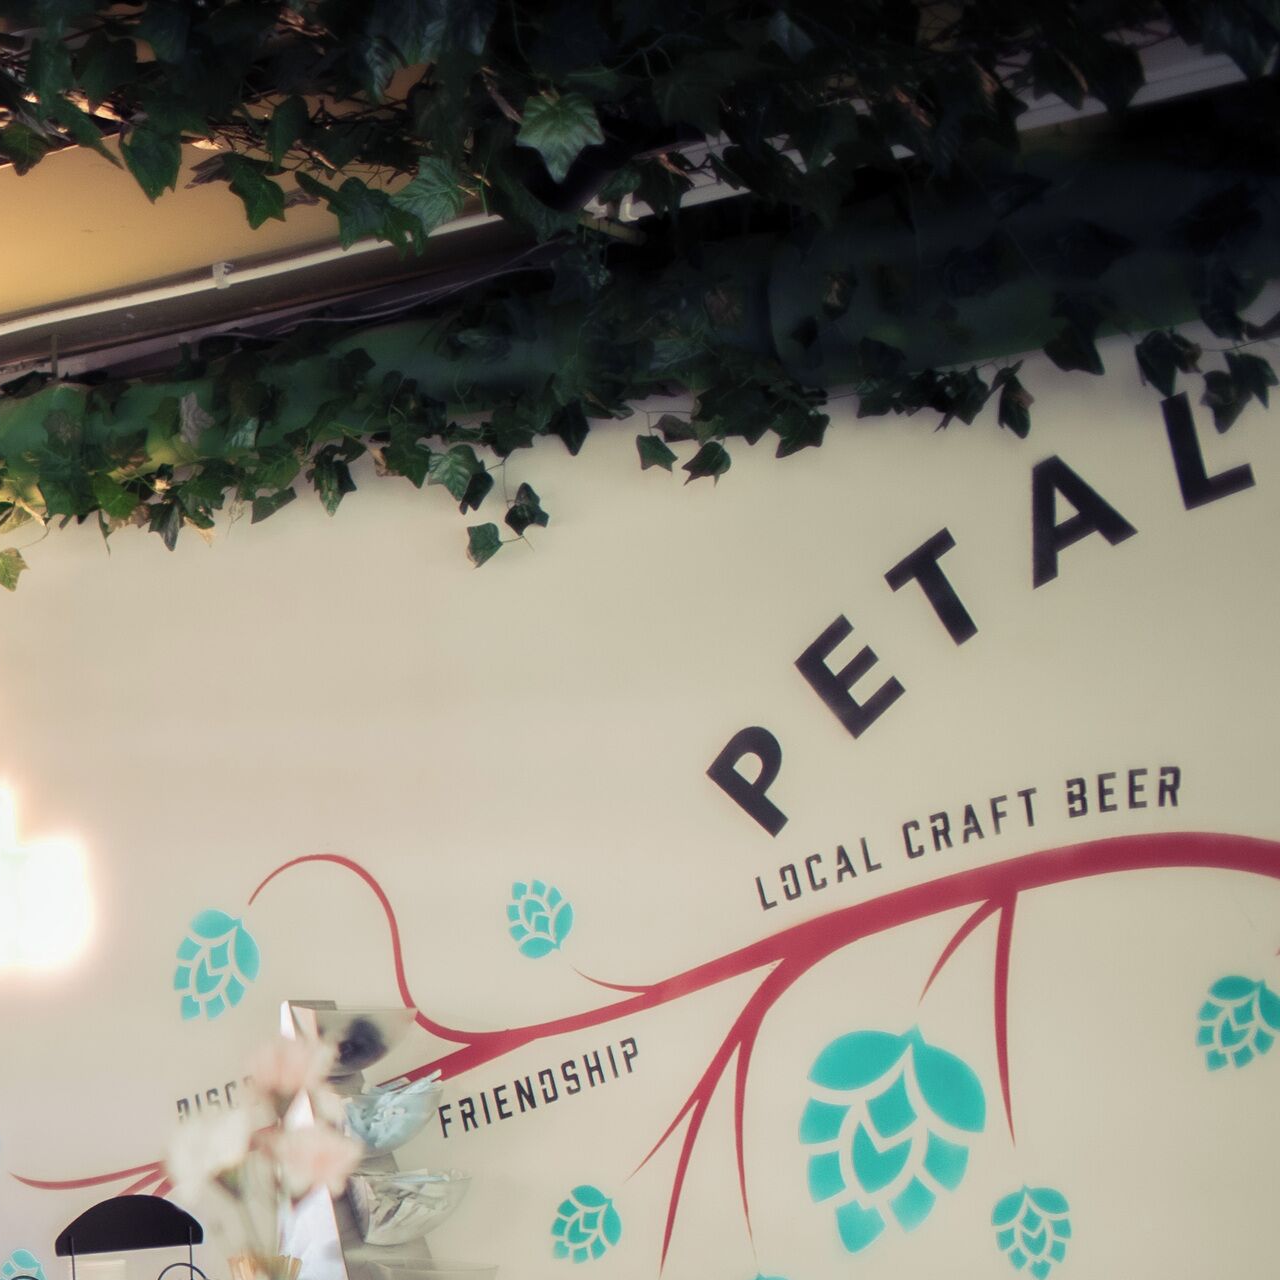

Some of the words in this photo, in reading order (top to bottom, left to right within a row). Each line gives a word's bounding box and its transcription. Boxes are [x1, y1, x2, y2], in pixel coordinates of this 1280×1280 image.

[705, 391, 1256, 838] PETAL
[755, 837, 883, 911] LOCAL
[902, 787, 1039, 860] CRAFT
[1065, 765, 1183, 819] BEER
[437, 1036, 640, 1139] FRIENDSHIP
